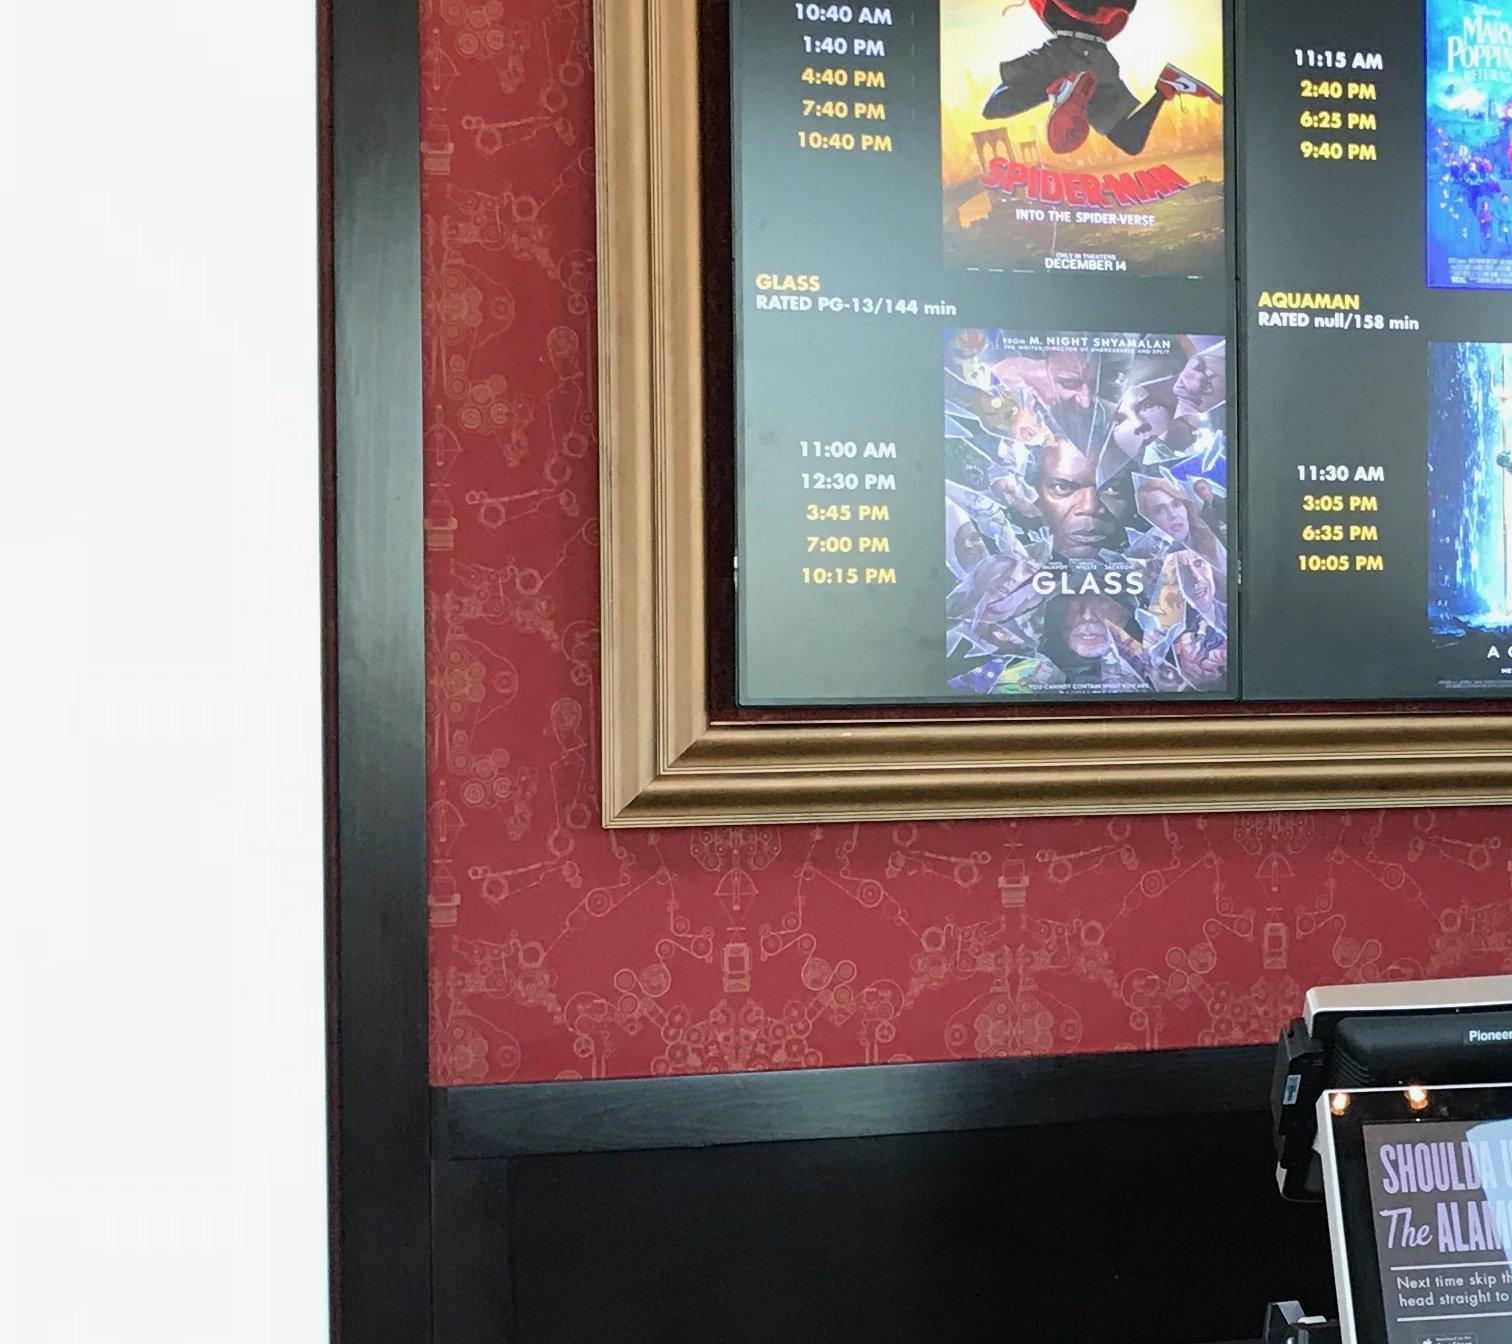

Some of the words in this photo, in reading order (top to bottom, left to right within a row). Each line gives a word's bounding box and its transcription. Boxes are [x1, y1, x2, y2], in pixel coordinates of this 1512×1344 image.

[795, 3, 853, 23] 10:40
[858, 8, 892, 25] AM
[803, 36, 847, 54] 1:40
[855, 39, 885, 56] PM
[1295, 50, 1347, 68] 11:15
[1352, 53, 1383, 70] AM
[801, 68, 848, 86] 4:40
[855, 70, 886, 88] PM
[1300, 81, 1342, 99] 2:40
[1348, 83, 1376, 100] PM
[803, 101, 848, 118] 7:40
[855, 102, 886, 119] PM
[1300, 112, 1342, 130] 6:25
[1348, 114, 1376, 130] PM
[798, 132, 855, 150] 10:40
[862, 135, 892, 152] PM
[1300, 143, 1342, 159] 9:40
[1348, 144, 1376, 160] PM
[1015, 209, 1044, 221] INTO
[1049, 210, 1071, 222] THE
[1076, 213, 1155, 226] SPIDER-VERSE
[756, 274, 821, 292] GLASS
[756, 295, 812, 311] RATED
[818, 296, 919, 316] PG-13/144
[924, 301, 956, 316] min
[1258, 292, 1359, 311] AQUAMAN
[1258, 312, 1309, 327] RATED
[1314, 314, 1384, 330] null/158
[1390, 317, 1419, 330] min
[799, 441, 857, 458] 11:00
[863, 442, 897, 459] AM
[801, 473, 858, 490] 12:30
[865, 473, 896, 490] PM
[1297, 465, 1349, 481] 11:30
[1354, 466, 1384, 481] AM
[807, 504, 852, 521] 3:45
[858, 505, 889, 521] PM
[1303, 496, 1343, 511] 3:05
[1350, 496, 1377, 511] PM
[1302, 526, 1343, 541] 6:35
[1350, 526, 1377, 540] PM
[807, 537, 852, 553] 7:00
[859, 537, 890, 553] PM
[1299, 556, 1350, 571] 10:05
[1356, 556, 1383, 570] PM
[802, 568, 860, 584] 10:15
[866, 568, 896, 584] PM
[1032, 572, 1144, 594] GLASS
[1379, 1141, 1496, 1194] SHOULDA
[1379, 1207, 1433, 1249] The
[1397, 1276, 1431, 1291] Next
[1435, 1275, 1464, 1288] time
[1469, 1272, 1497, 1288] skip
[1399, 1293, 1434, 1308] head
[1440, 1290, 1491, 1309] straight
[1496, 1289, 1509, 1304] to
